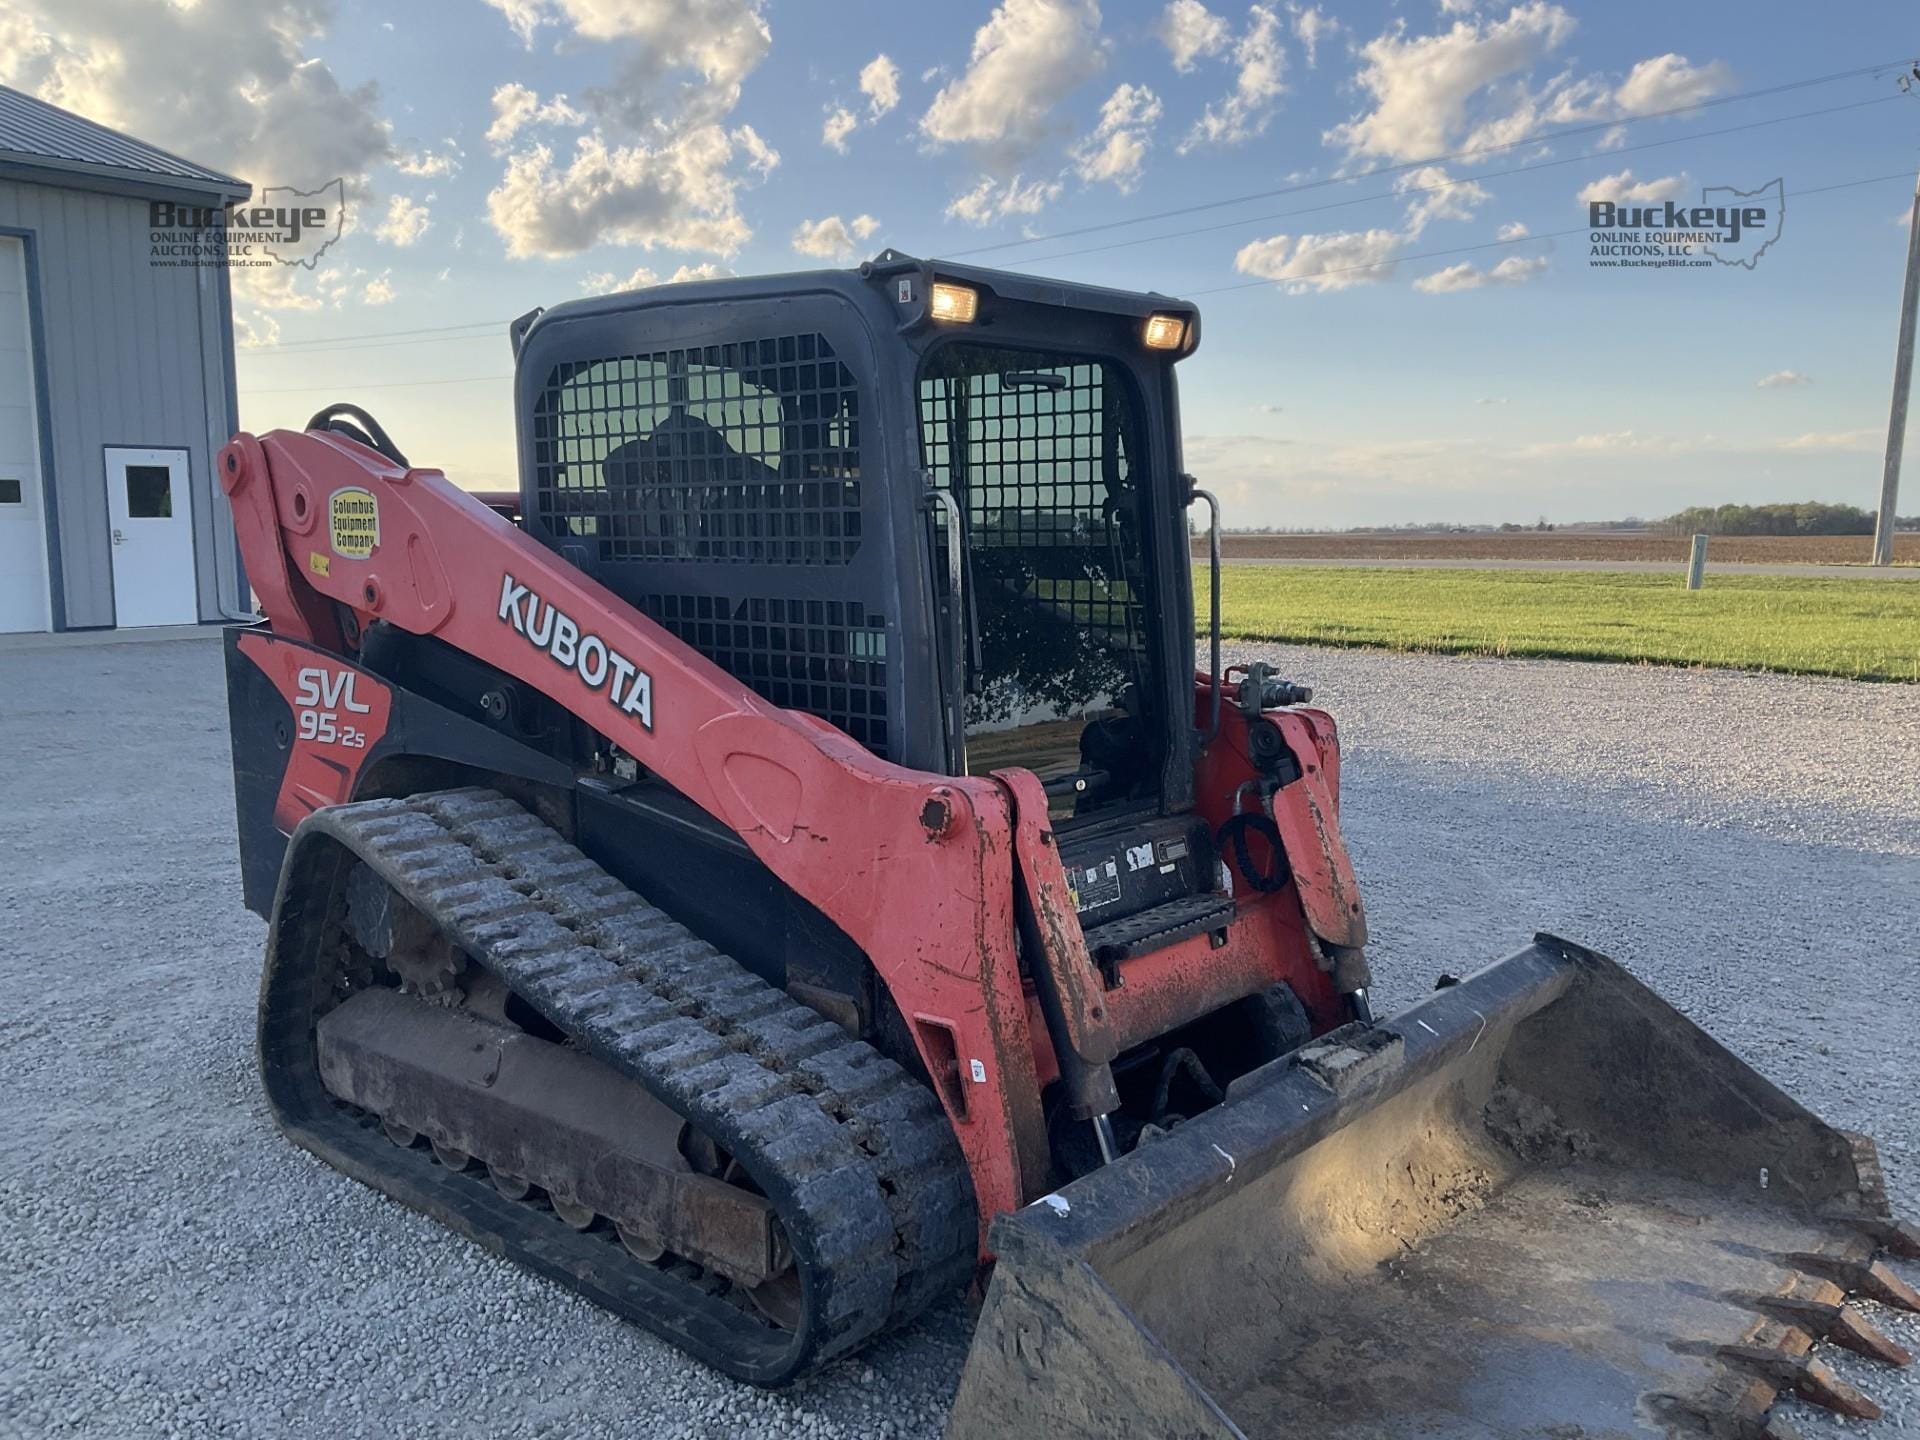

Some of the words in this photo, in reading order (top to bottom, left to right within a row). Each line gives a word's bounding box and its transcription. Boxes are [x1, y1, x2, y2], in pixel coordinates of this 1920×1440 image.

[333, 499, 375, 514] Columbus
[333, 516, 376, 532] Equipment
[336, 533, 375, 548] Company
[498, 573, 653, 730] KUBOTA
[295, 668, 370, 713] SVL
